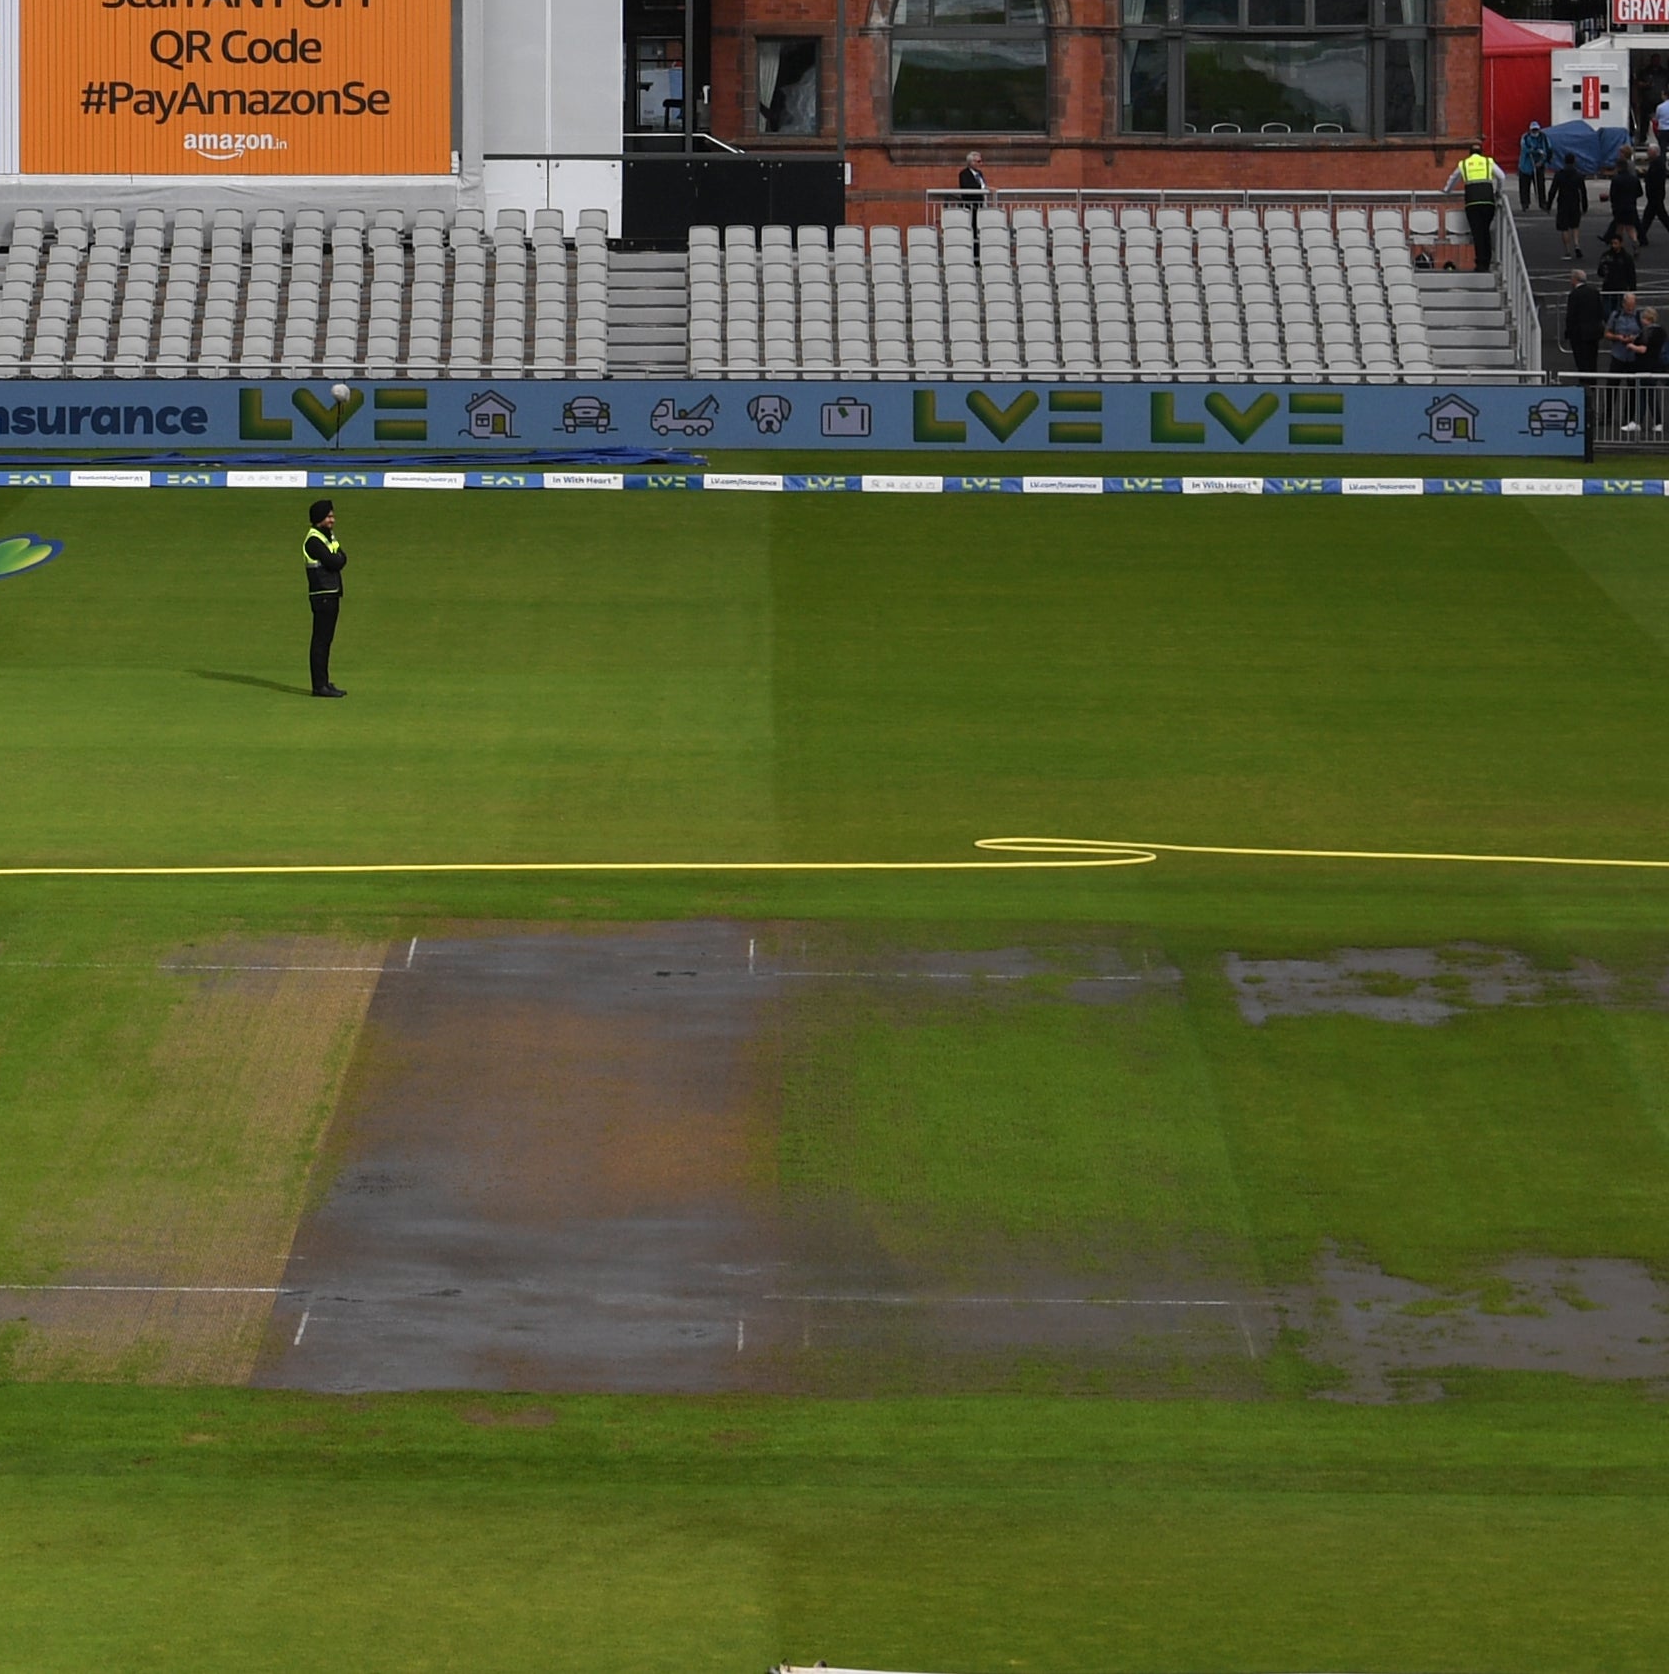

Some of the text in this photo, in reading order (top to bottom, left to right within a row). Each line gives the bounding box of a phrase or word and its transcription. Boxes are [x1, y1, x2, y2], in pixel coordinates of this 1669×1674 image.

[150, 28, 322, 70] QR Code
[81, 81, 390, 124] #PayAmazonSe
[183, 133, 288, 150] amazon.in
[552, 476, 612, 485] In With Heart
[1192, 481, 1251, 490] In With Heart
